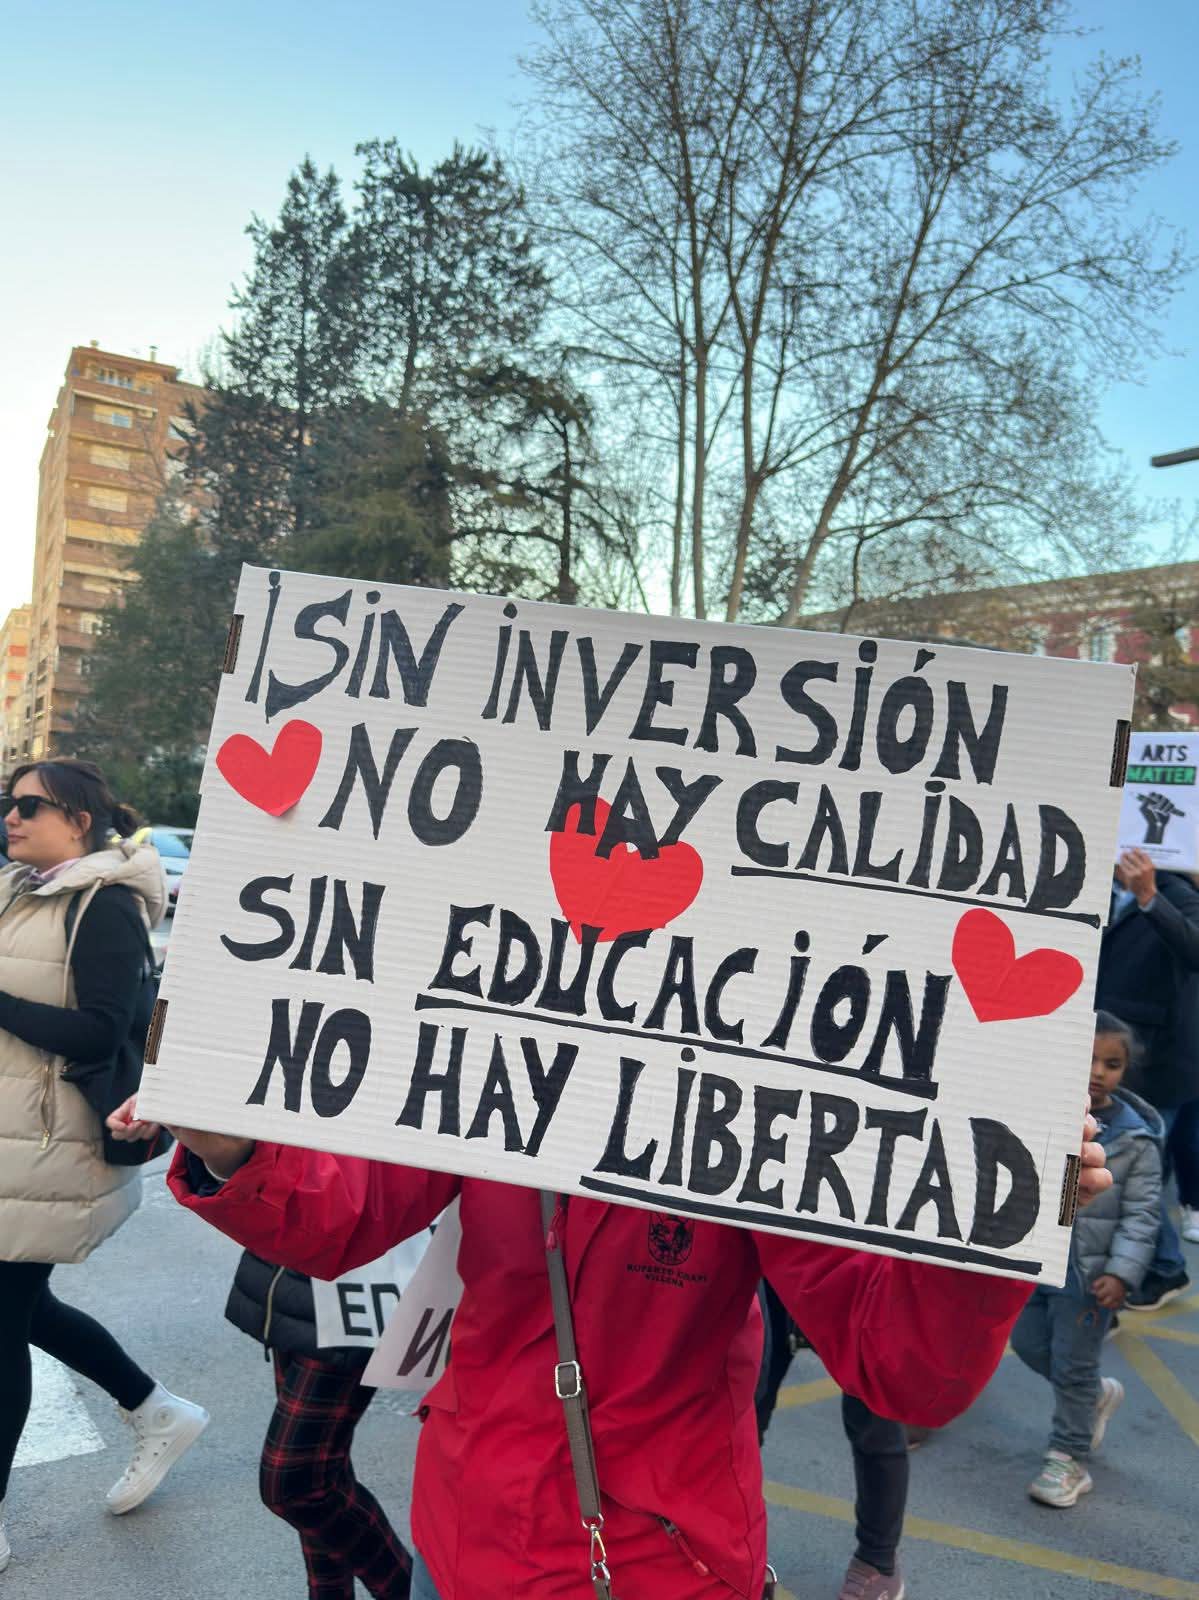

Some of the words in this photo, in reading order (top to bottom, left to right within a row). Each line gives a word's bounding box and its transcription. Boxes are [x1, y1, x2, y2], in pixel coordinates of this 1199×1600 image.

[318, 722, 484, 847] NO
[545, 749, 723, 860] HAY
[1141, 744, 1188, 761] ARTS
[220, 873, 386, 984] SIN
[246, 998, 371, 1118] NO
[395, 1021, 579, 1157] HAY
